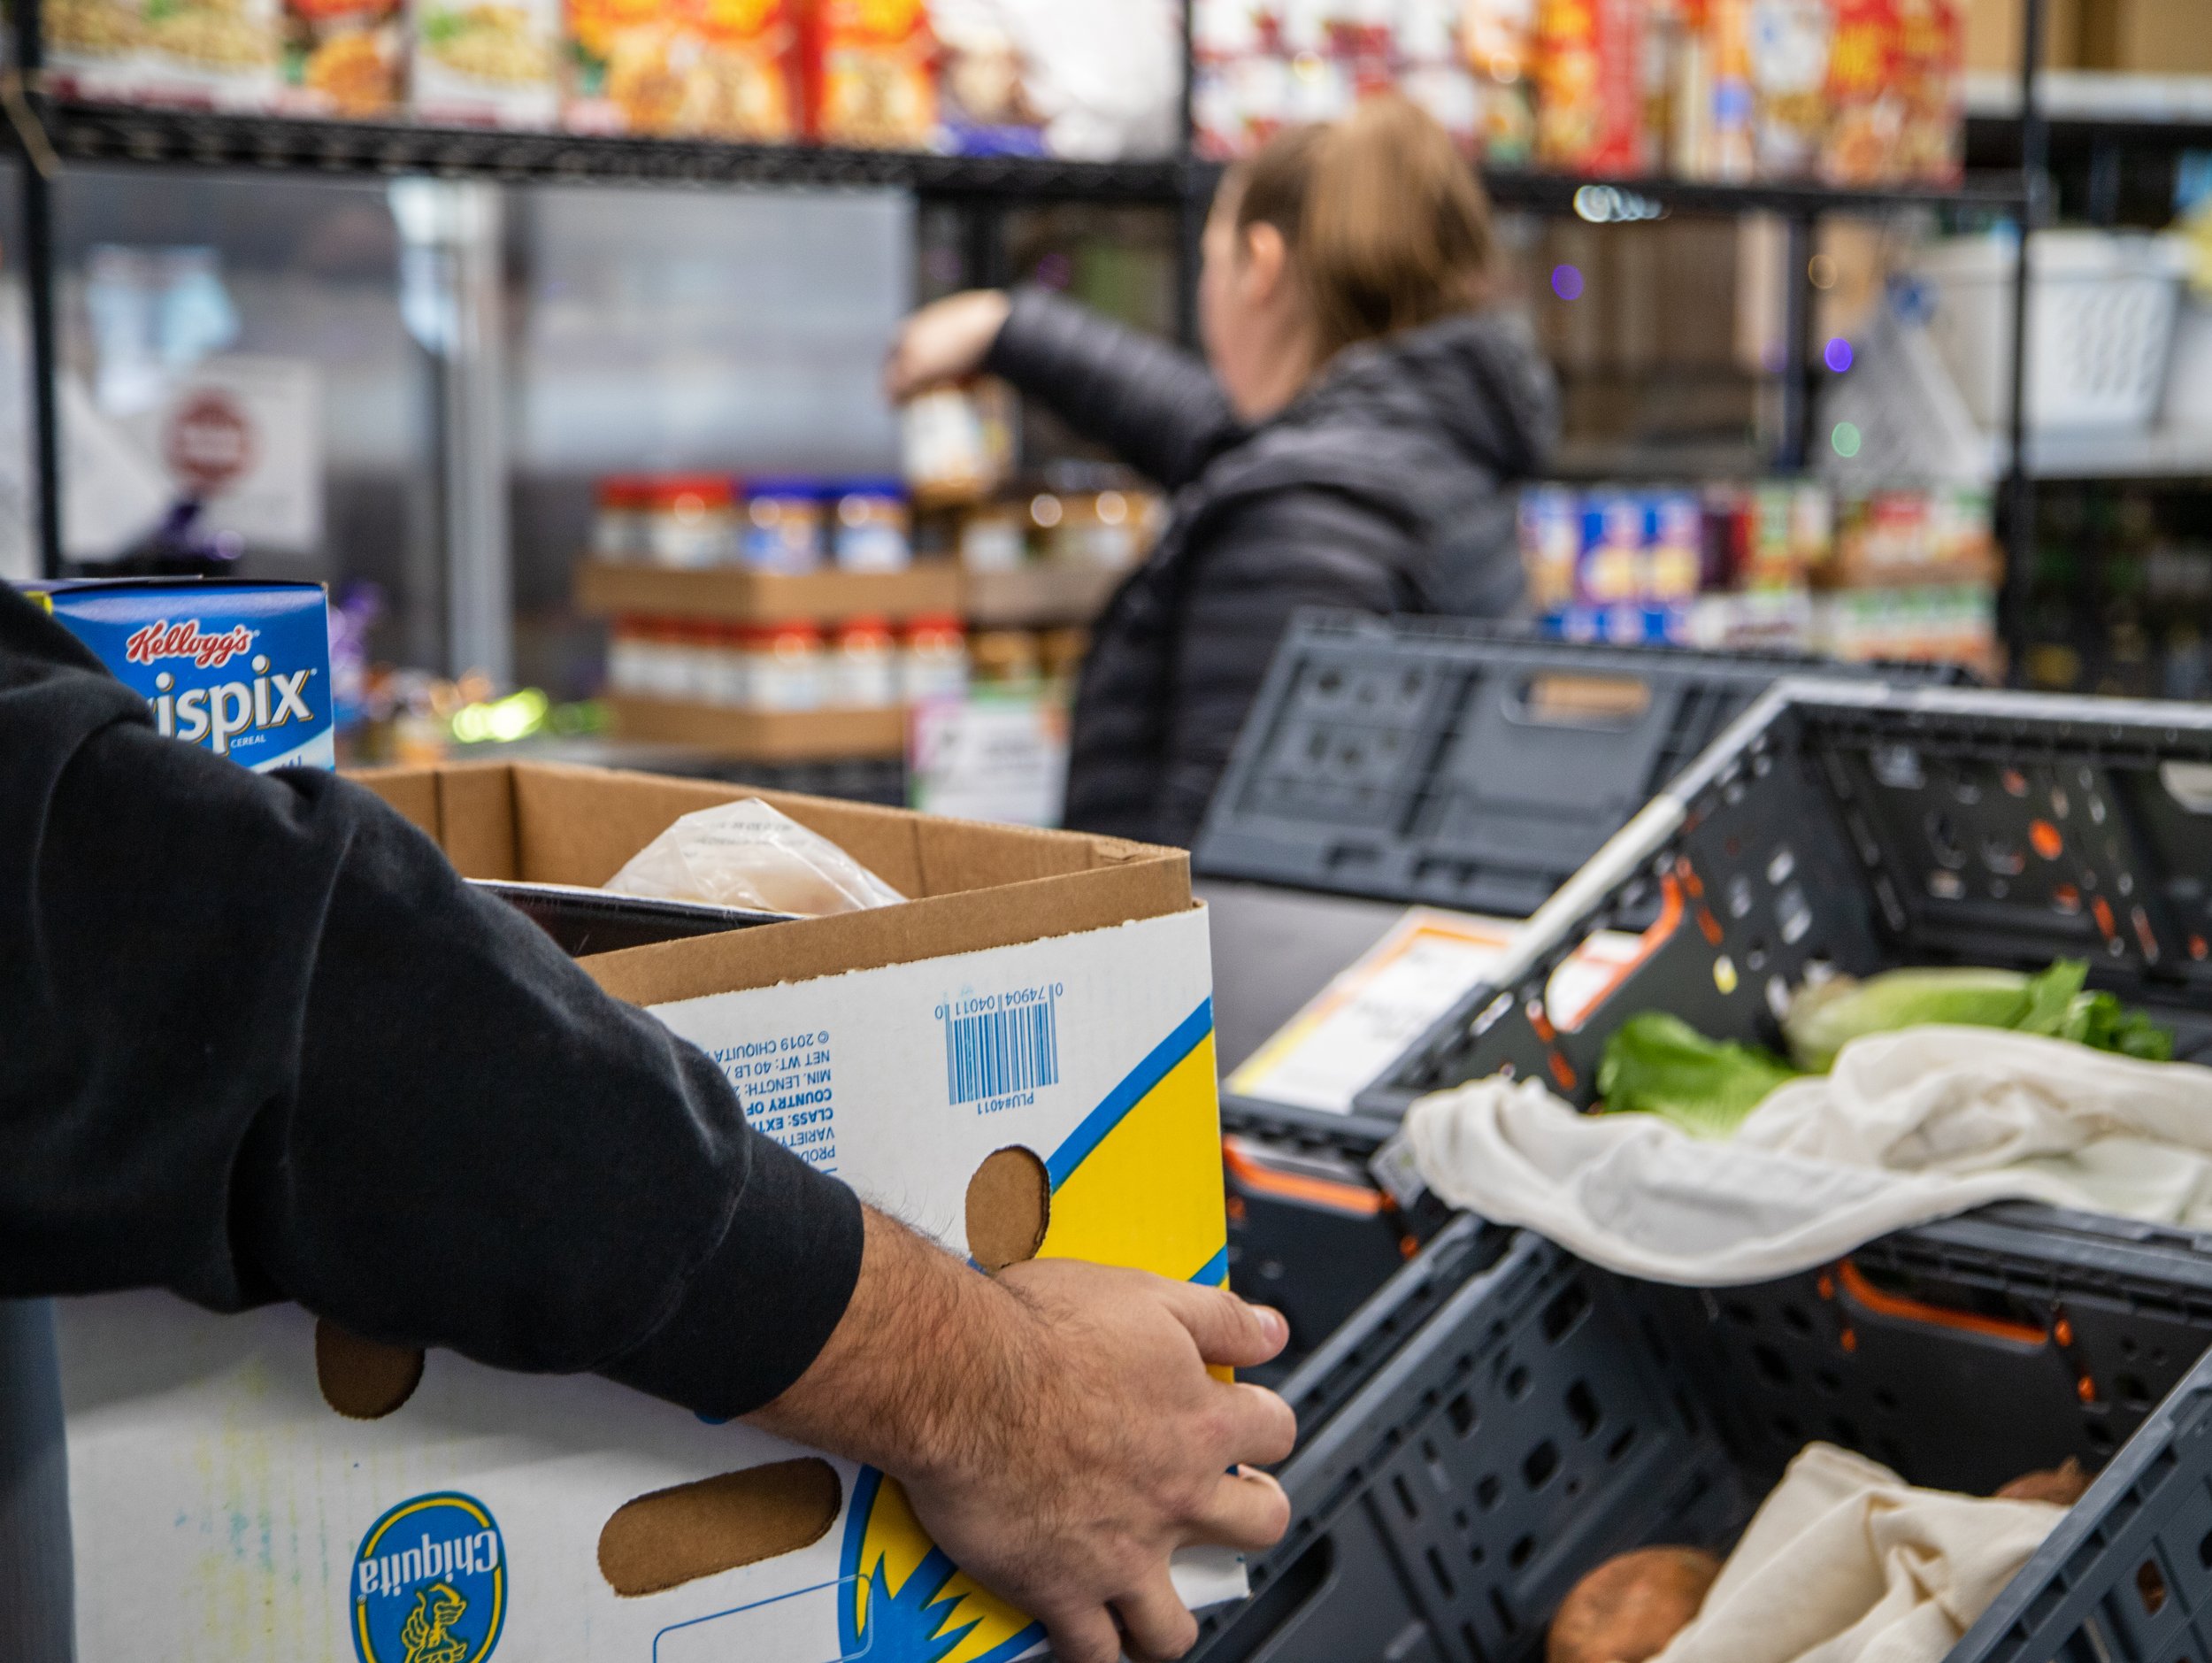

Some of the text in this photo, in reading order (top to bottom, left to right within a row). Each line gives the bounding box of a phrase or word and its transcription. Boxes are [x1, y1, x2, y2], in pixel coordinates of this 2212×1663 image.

[127, 619, 252, 668] Kellogg's
[148, 654, 313, 756] ispix
[230, 734, 267, 749] CEREAL
[956, 995, 995, 1016] 04011
[1005, 985, 1046, 1006] 74904
[713, 1040, 778, 1063] CHIQUITA
[780, 1033, 814, 1051] 2019
[754, 1061, 772, 1075] 40
[776, 1055, 801, 1072] WT:
[804, 1050, 830, 1066] NET
[734, 1065, 750, 1079] LB
[803, 1068, 831, 1086] MIN.
[745, 1074, 800, 1097] LENGTH:
[746, 1088, 833, 1116] COUNTRY OF
[977, 1092, 1034, 1115] PLU#4011
[787, 1107, 834, 1128] CLASS:
[800, 1145, 836, 1164] PROD
[357, 1528, 500, 1598] Chiquita
